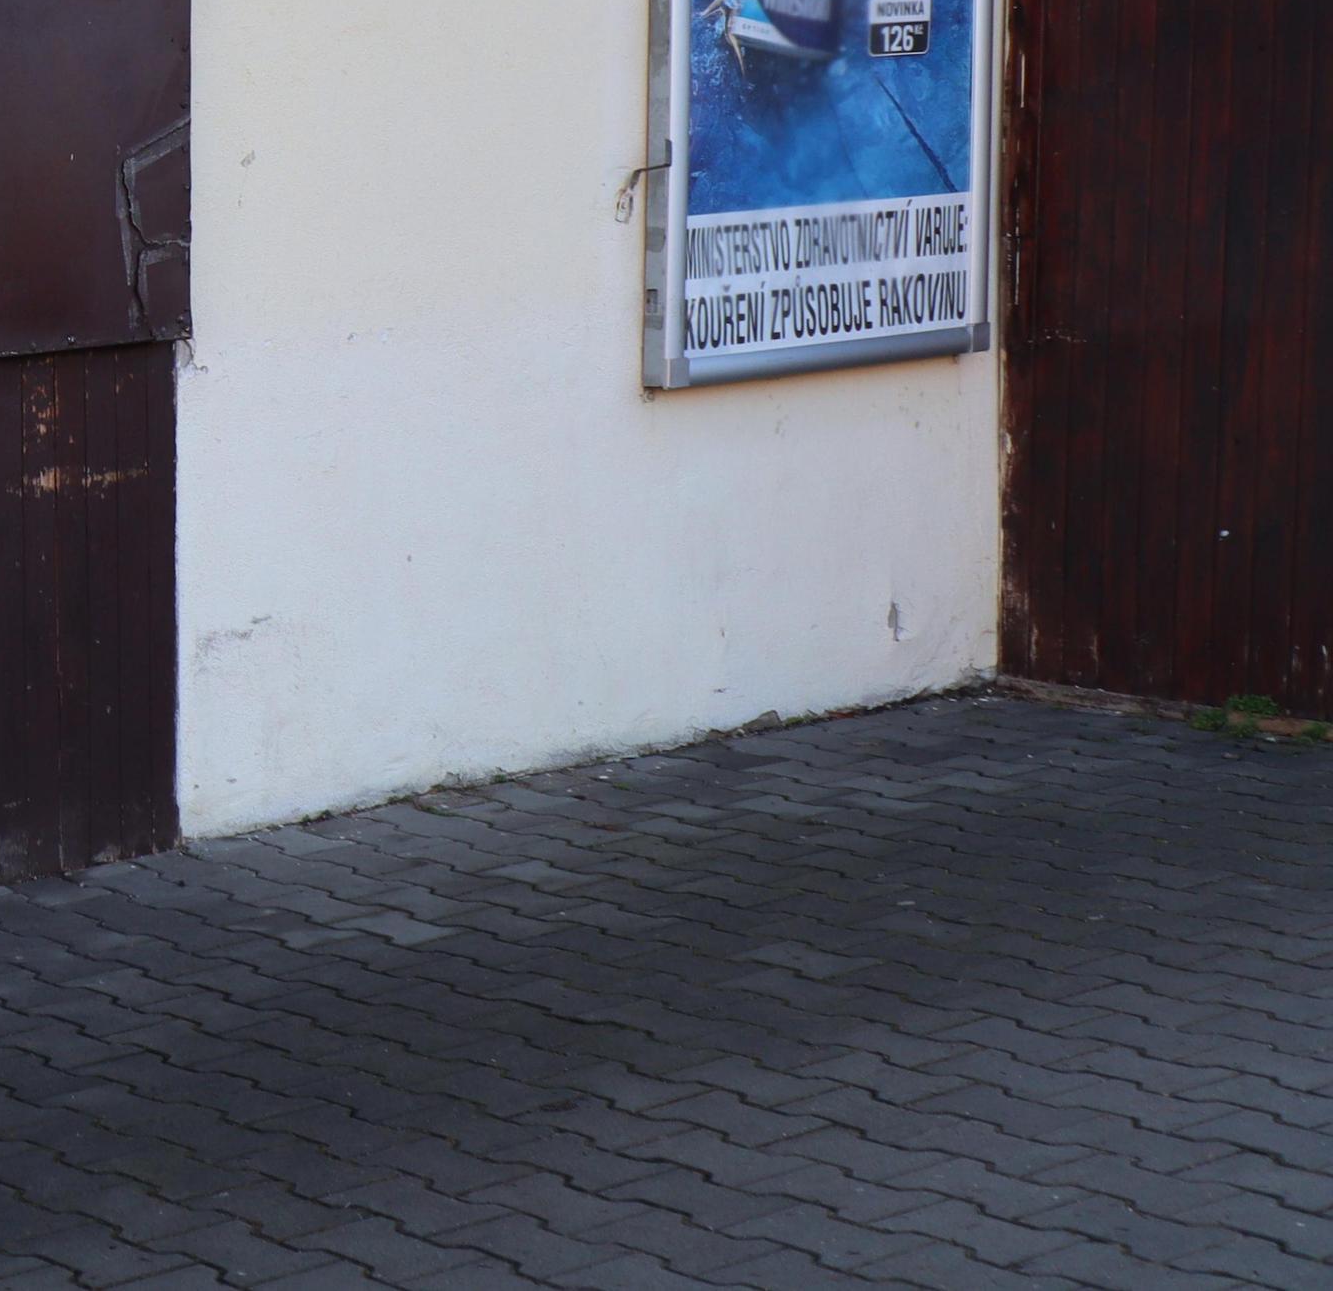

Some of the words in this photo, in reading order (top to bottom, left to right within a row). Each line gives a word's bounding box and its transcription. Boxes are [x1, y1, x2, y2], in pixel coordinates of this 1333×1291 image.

[876, 0, 925, 17] NOVINKA
[881, 25, 914, 52] 126
[686, 218, 790, 280] MINISTERSTVO
[795, 199, 912, 270] ZDRAVOTNICTVÍ
[685, 282, 765, 350] KOUŘENÍ
[771, 275, 873, 341] ZPŮSOBUJE
[880, 270, 967, 327] RAKOVINU
